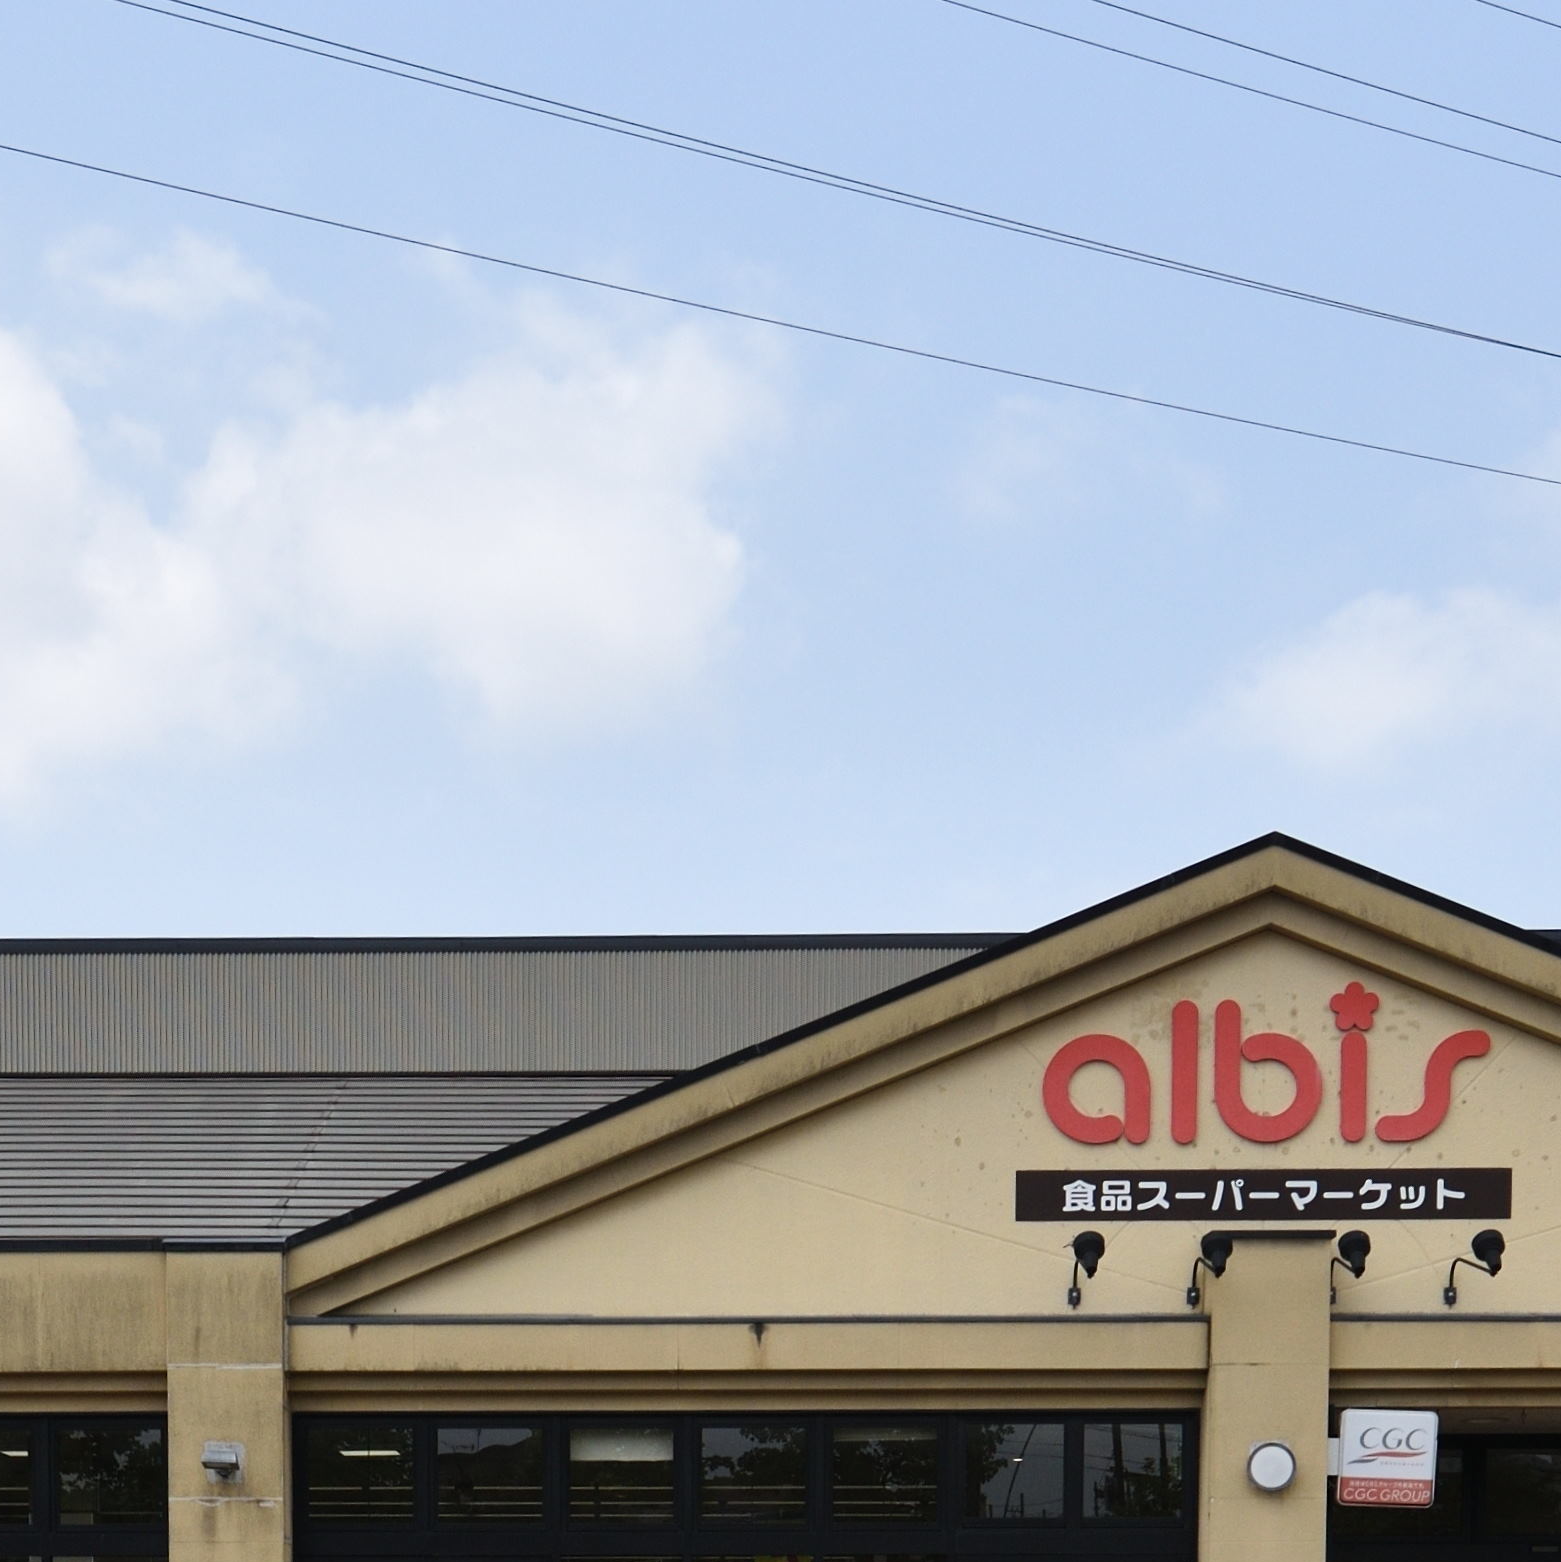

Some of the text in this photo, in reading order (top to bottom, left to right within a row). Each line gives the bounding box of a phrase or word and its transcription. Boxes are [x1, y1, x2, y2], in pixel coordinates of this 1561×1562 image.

[1042, 982, 1492, 1145] albis
[1061, 1178, 1467, 1213] 食品スーパーマーケット
[1359, 1426, 1429, 1451] CGC
[1343, 1487, 1431, 1503] CGC GROUP
